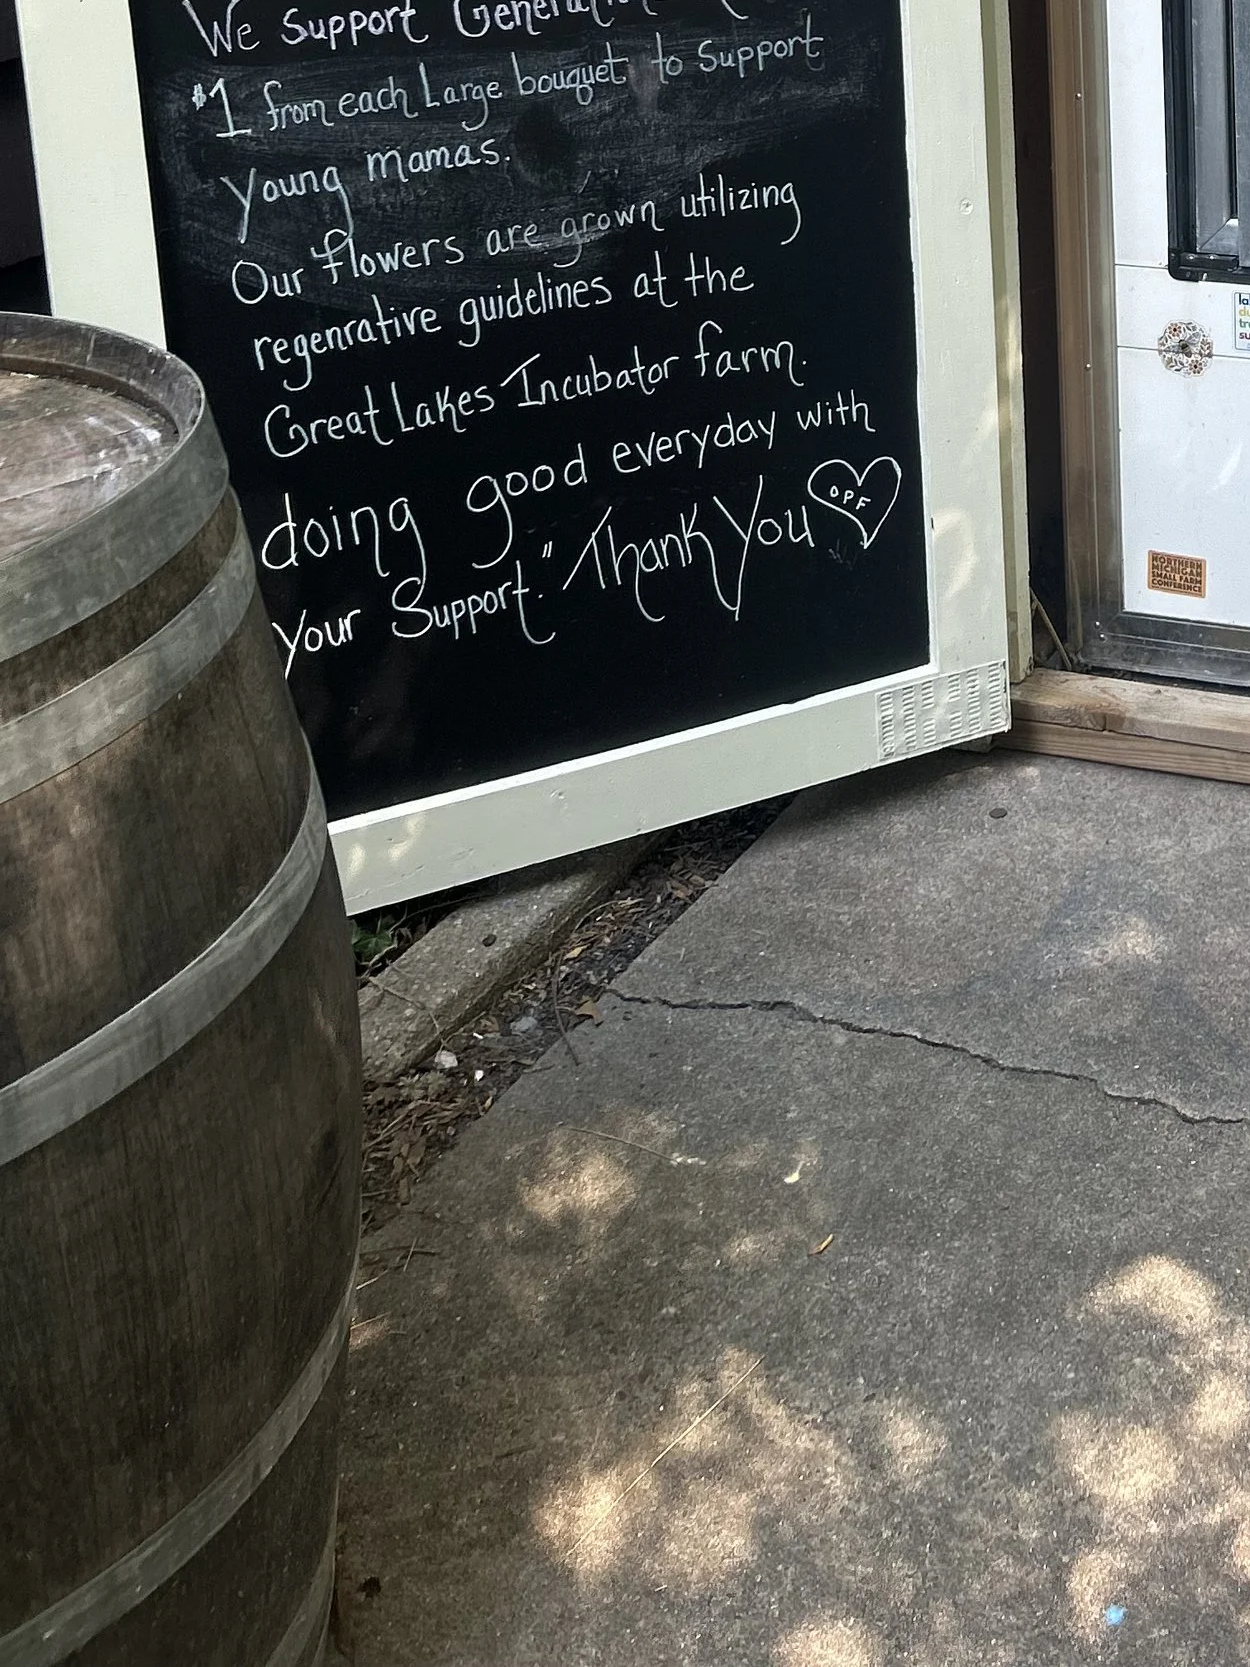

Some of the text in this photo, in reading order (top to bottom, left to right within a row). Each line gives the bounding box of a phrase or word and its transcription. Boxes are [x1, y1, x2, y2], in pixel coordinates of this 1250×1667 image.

[191, 77, 252, 139] $1
[262, 79, 335, 132] from
[338, 75, 419, 119] each
[418, 61, 504, 132] Large
[510, 41, 629, 106] bouquet
[651, 31, 684, 85] to
[364, 138, 511, 183] mamas.
[230, 172, 802, 305] Our flowers are grown utilizing
[253, 249, 755, 392] regenrative guidelines at the
[263, 319, 808, 459] Great Lakes Incubator farm.
[261, 388, 877, 604] doing good everyday with
[562, 501, 735, 622] Thank
[712, 474, 815, 622] You
[1152, 555, 1203, 571] NORTHERN
[1152, 563, 1202, 578] MICHIGAN
[1152, 570, 1202, 586] SMALL FARM
[1152, 578, 1203, 593] CONFERENCE
